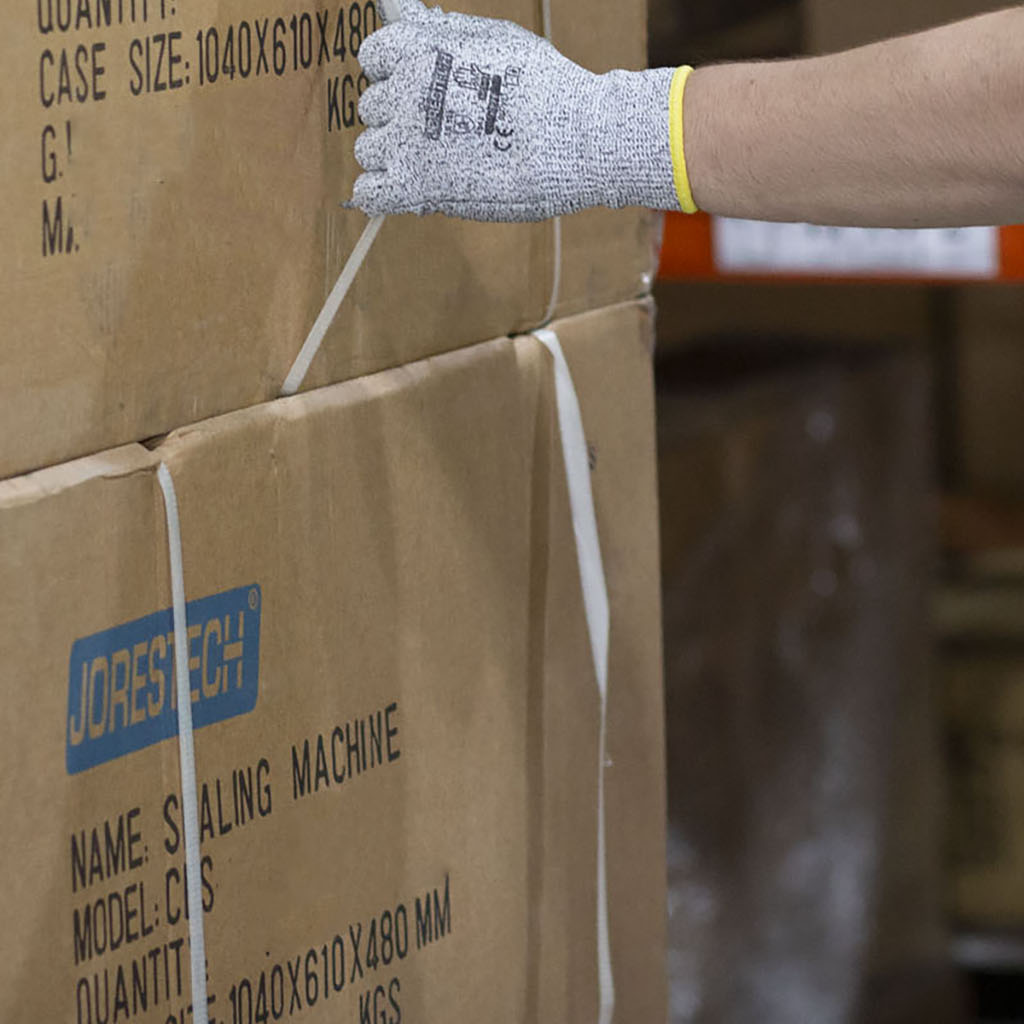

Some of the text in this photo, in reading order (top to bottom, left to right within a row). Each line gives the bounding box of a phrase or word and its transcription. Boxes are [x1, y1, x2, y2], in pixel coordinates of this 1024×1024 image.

[39, 42, 107, 108] CASE
[70, 702, 401, 893] NAME: SALING MACHINE
